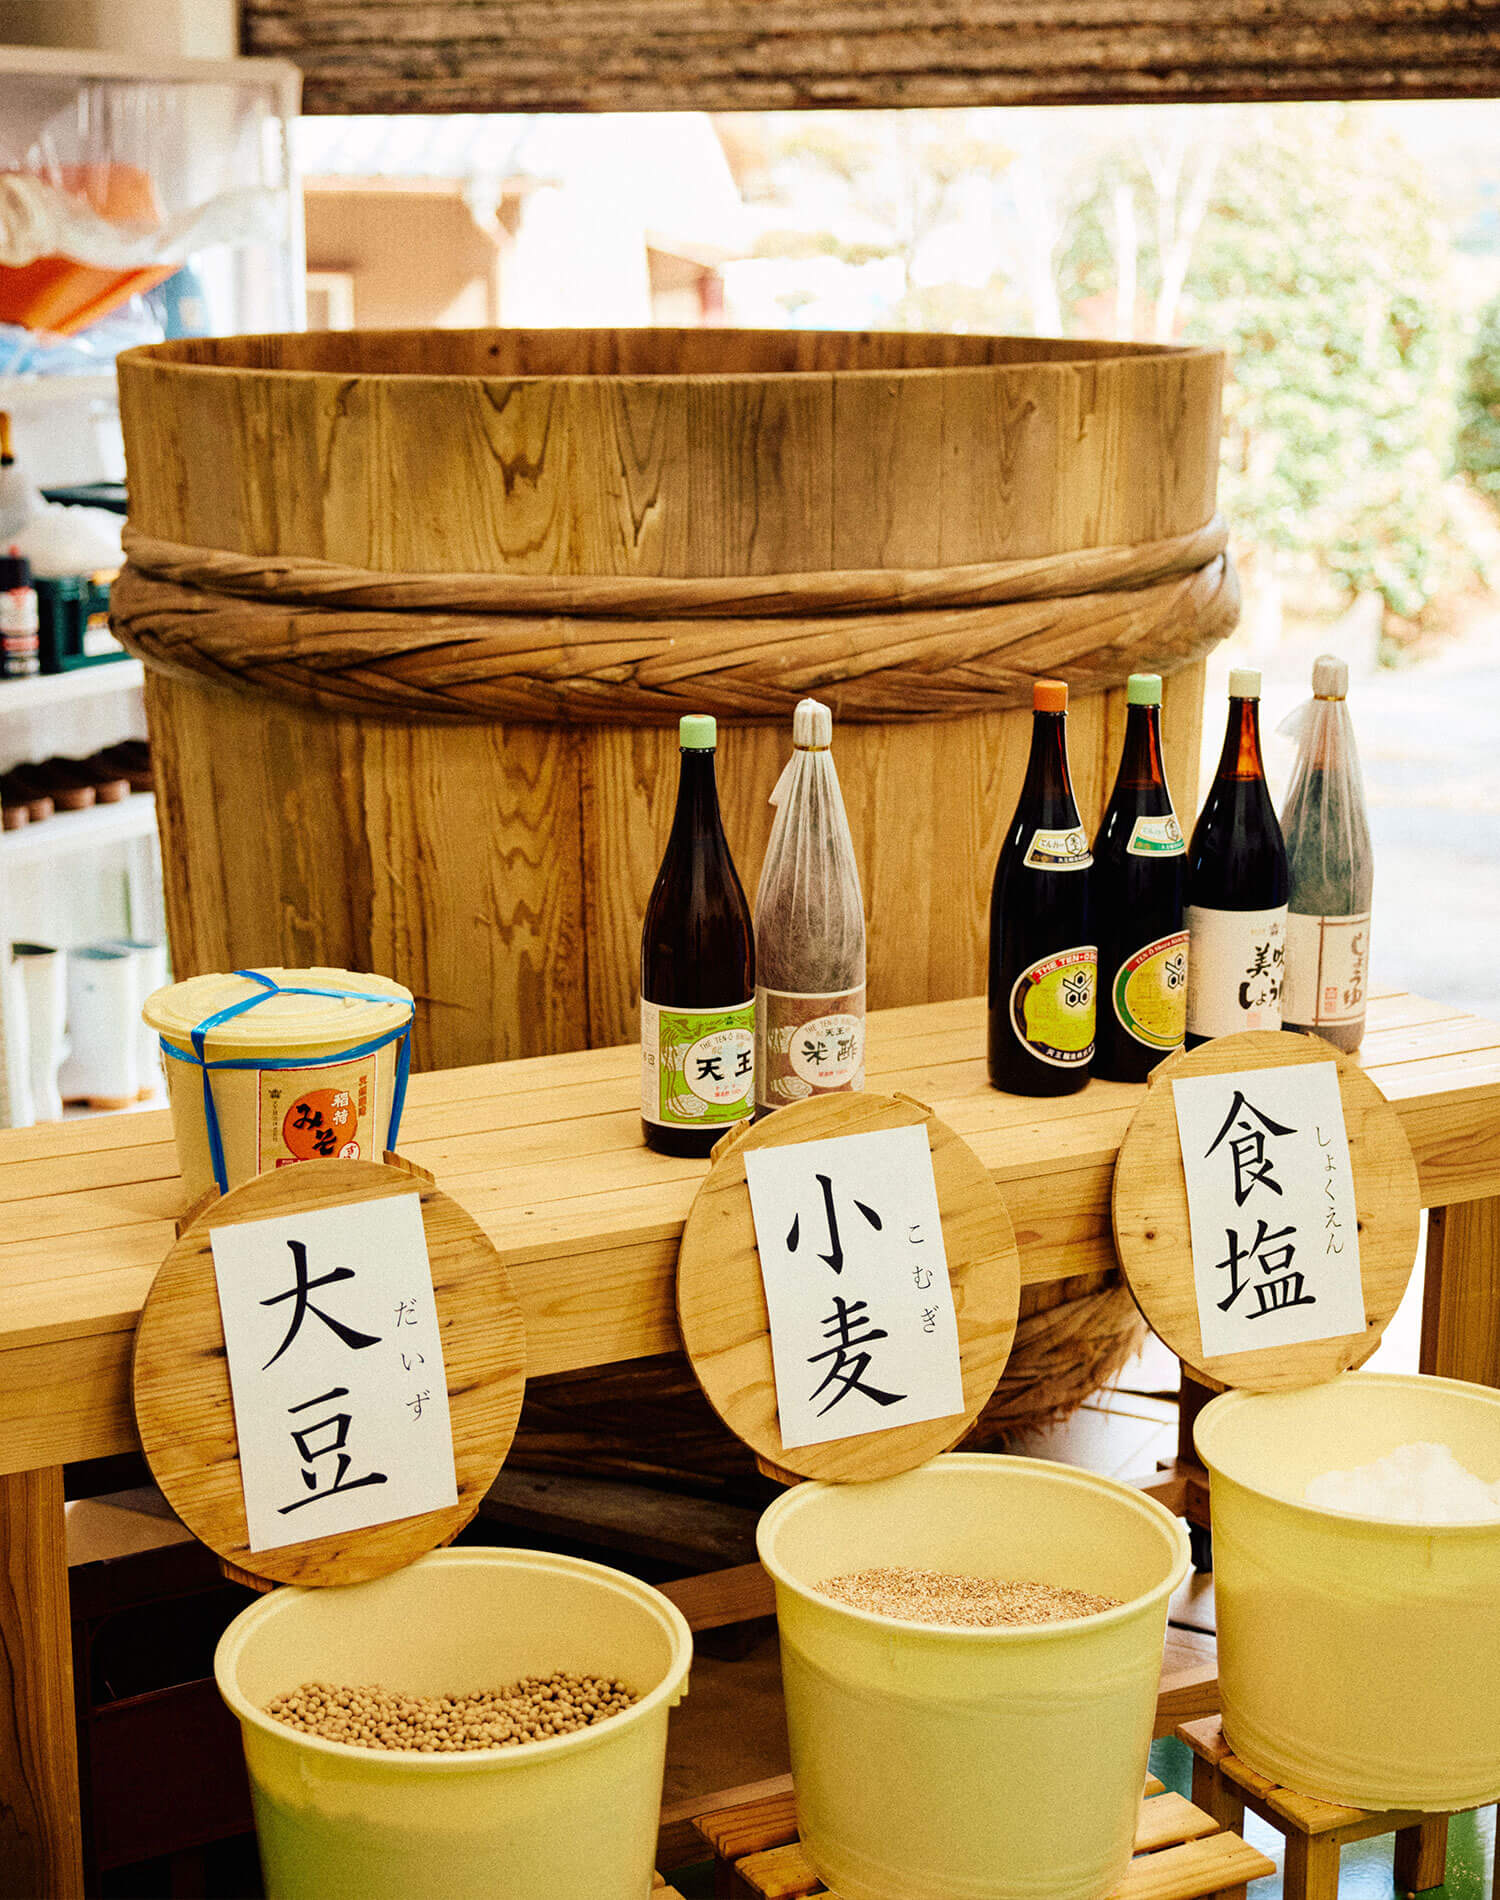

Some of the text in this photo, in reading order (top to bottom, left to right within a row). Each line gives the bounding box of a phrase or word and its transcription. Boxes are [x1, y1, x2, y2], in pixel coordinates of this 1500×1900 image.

[1245, 946, 1286, 983] 美味
[1343, 931, 1365, 1010] しょうゆ
[696, 1049, 753, 1082] 天王
[801, 1034, 858, 1066] 米酢
[825, 1026, 845, 1037] 天王
[292, 1102, 338, 1156] みそ
[330, 1091, 350, 1126] 稲荷
[1203, 1090, 1317, 1320] 食塩
[1315, 1126, 1345, 1255] しょくえん
[786, 1173, 908, 1418] 小麦
[907, 1224, 940, 1334] こむぎ
[259, 1239, 389, 1515] 大豆
[393, 1297, 431, 1422] だいず
